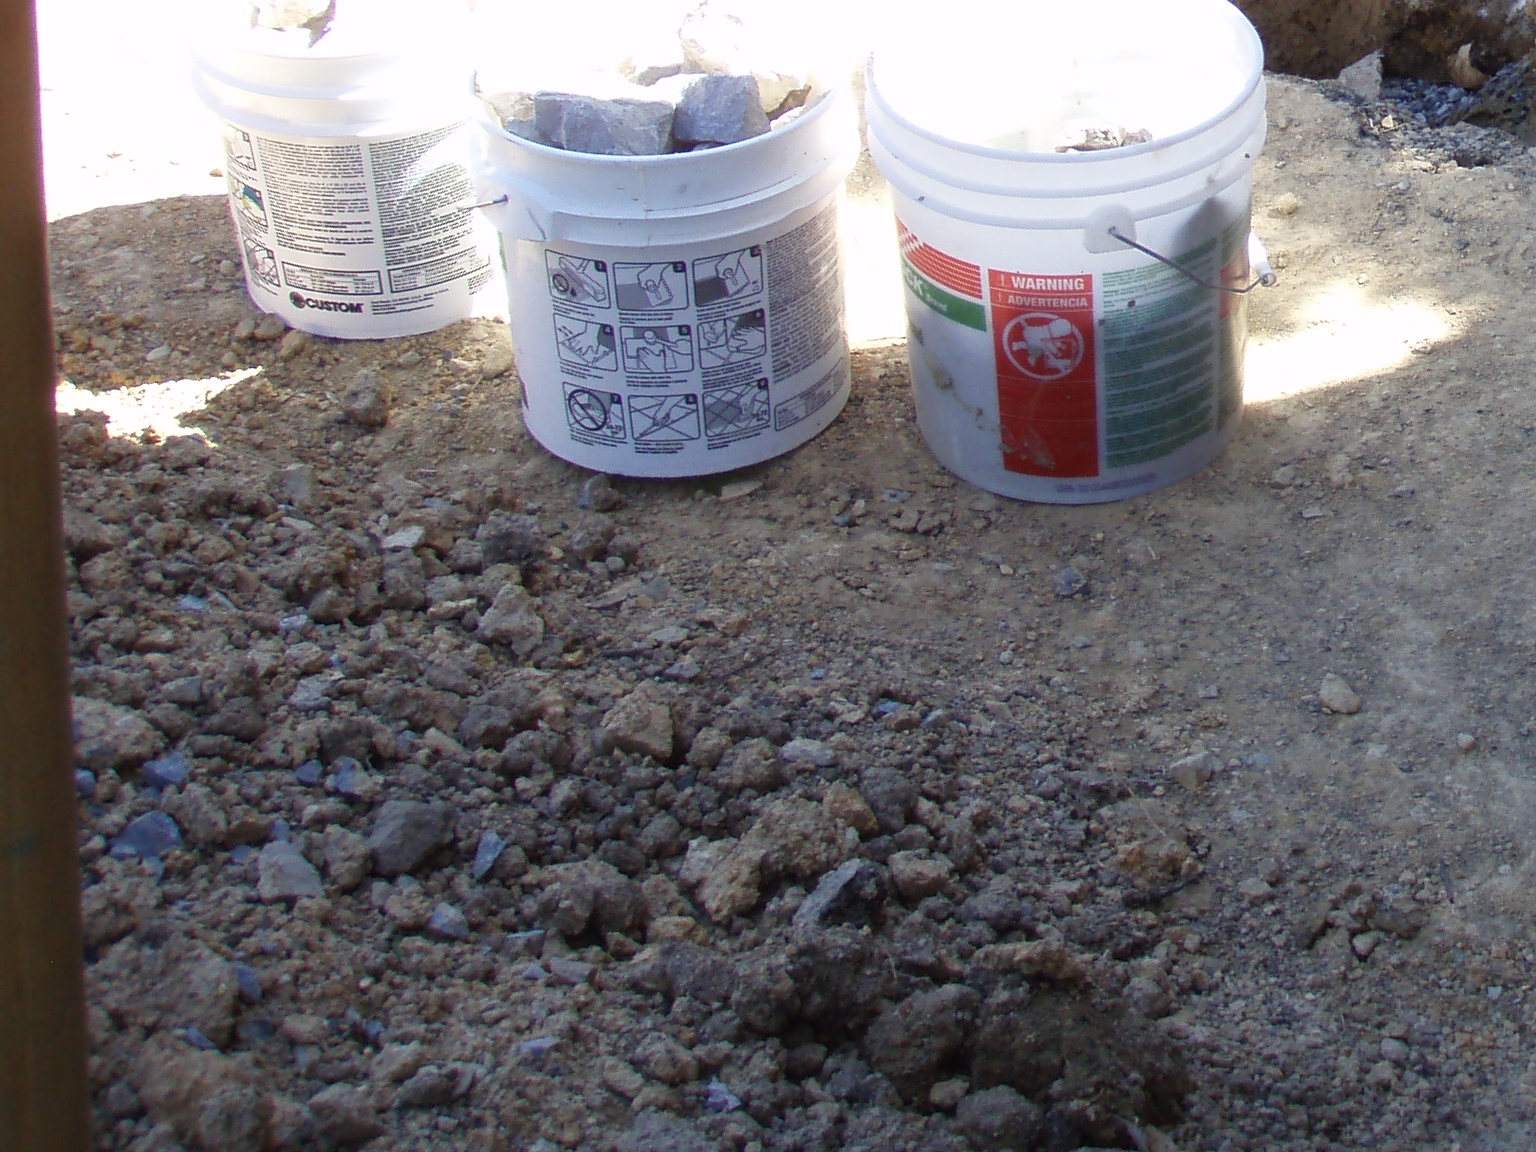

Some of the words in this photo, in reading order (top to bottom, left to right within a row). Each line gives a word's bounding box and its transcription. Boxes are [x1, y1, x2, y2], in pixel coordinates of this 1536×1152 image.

[1011, 275, 1085, 291] WARNING
[306, 297, 362, 314] CUSTOM
[1008, 294, 1088, 308] ADVERTENCIA
